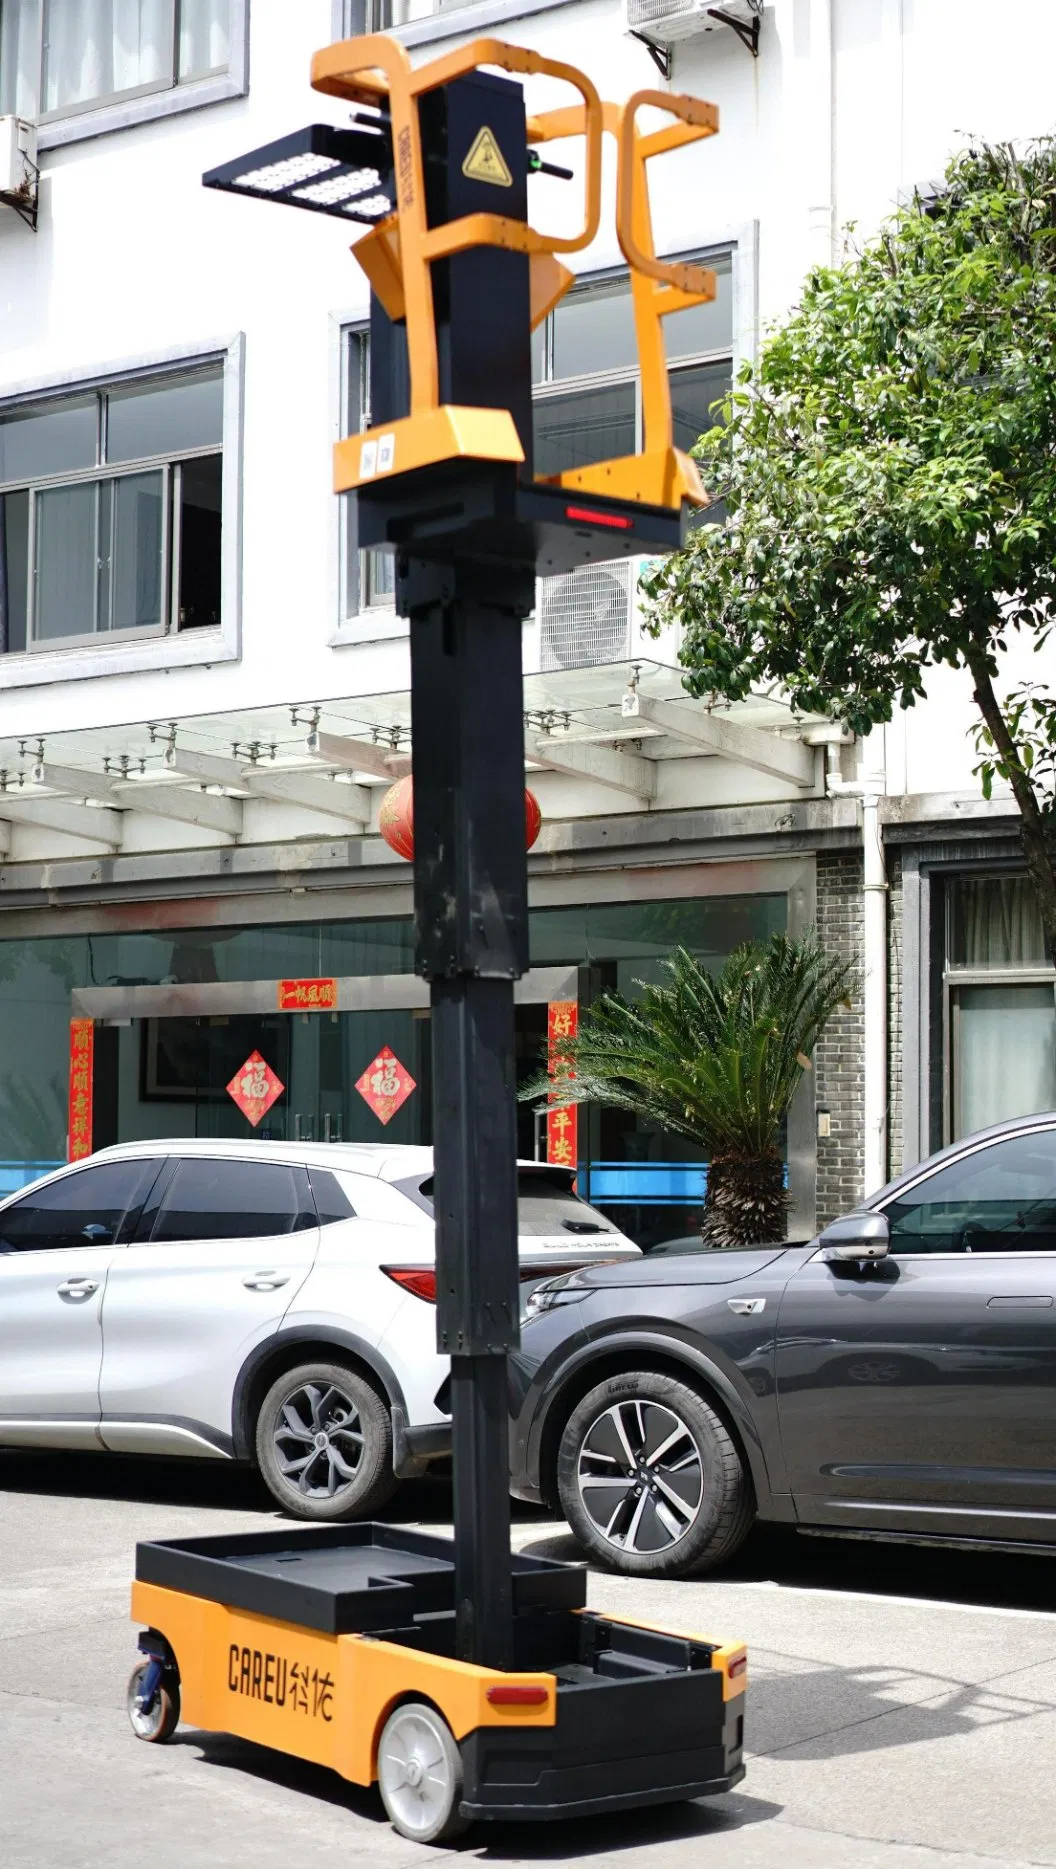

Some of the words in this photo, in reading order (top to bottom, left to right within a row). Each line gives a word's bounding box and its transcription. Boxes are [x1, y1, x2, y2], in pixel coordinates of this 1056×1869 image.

[241, 1061, 270, 1099] 福
[370, 1057, 401, 1097] 福
[229, 1644, 287, 1707] CAREU
